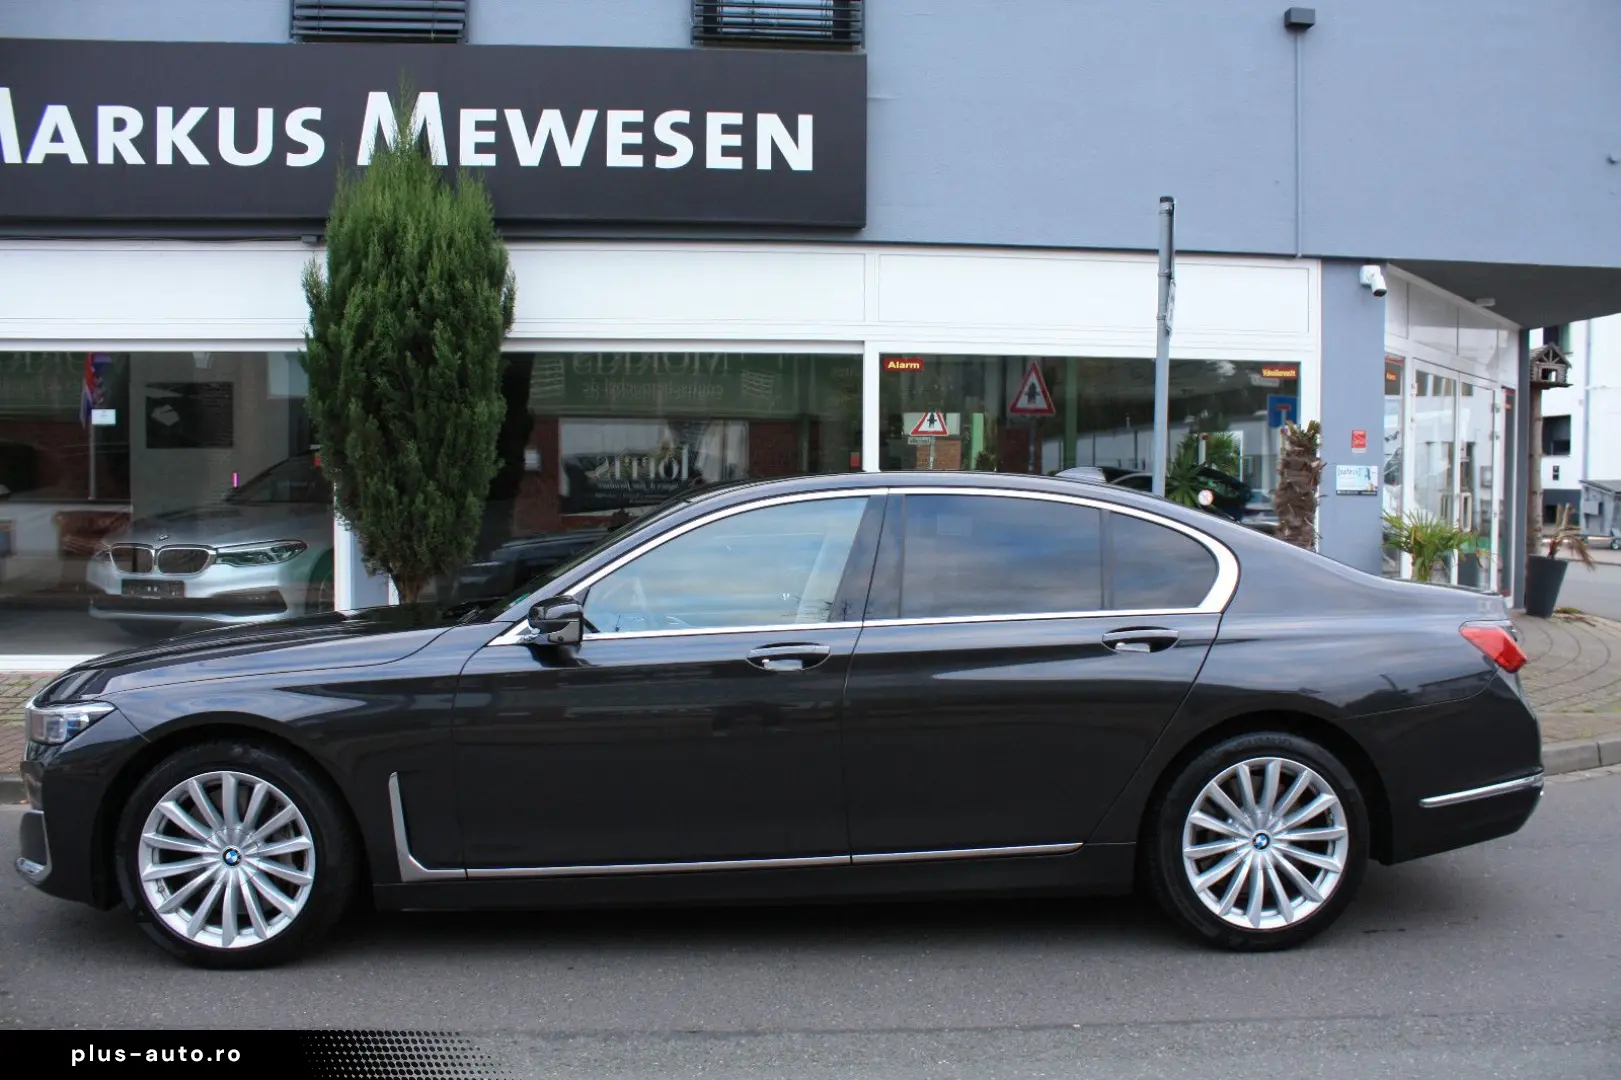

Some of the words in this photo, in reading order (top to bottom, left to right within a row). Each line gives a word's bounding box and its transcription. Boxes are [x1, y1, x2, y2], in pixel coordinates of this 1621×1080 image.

[0, 87, 325, 167] ARKUS
[356, 91, 814, 171] MEWESEN
[887, 360, 920, 369] Alarm
